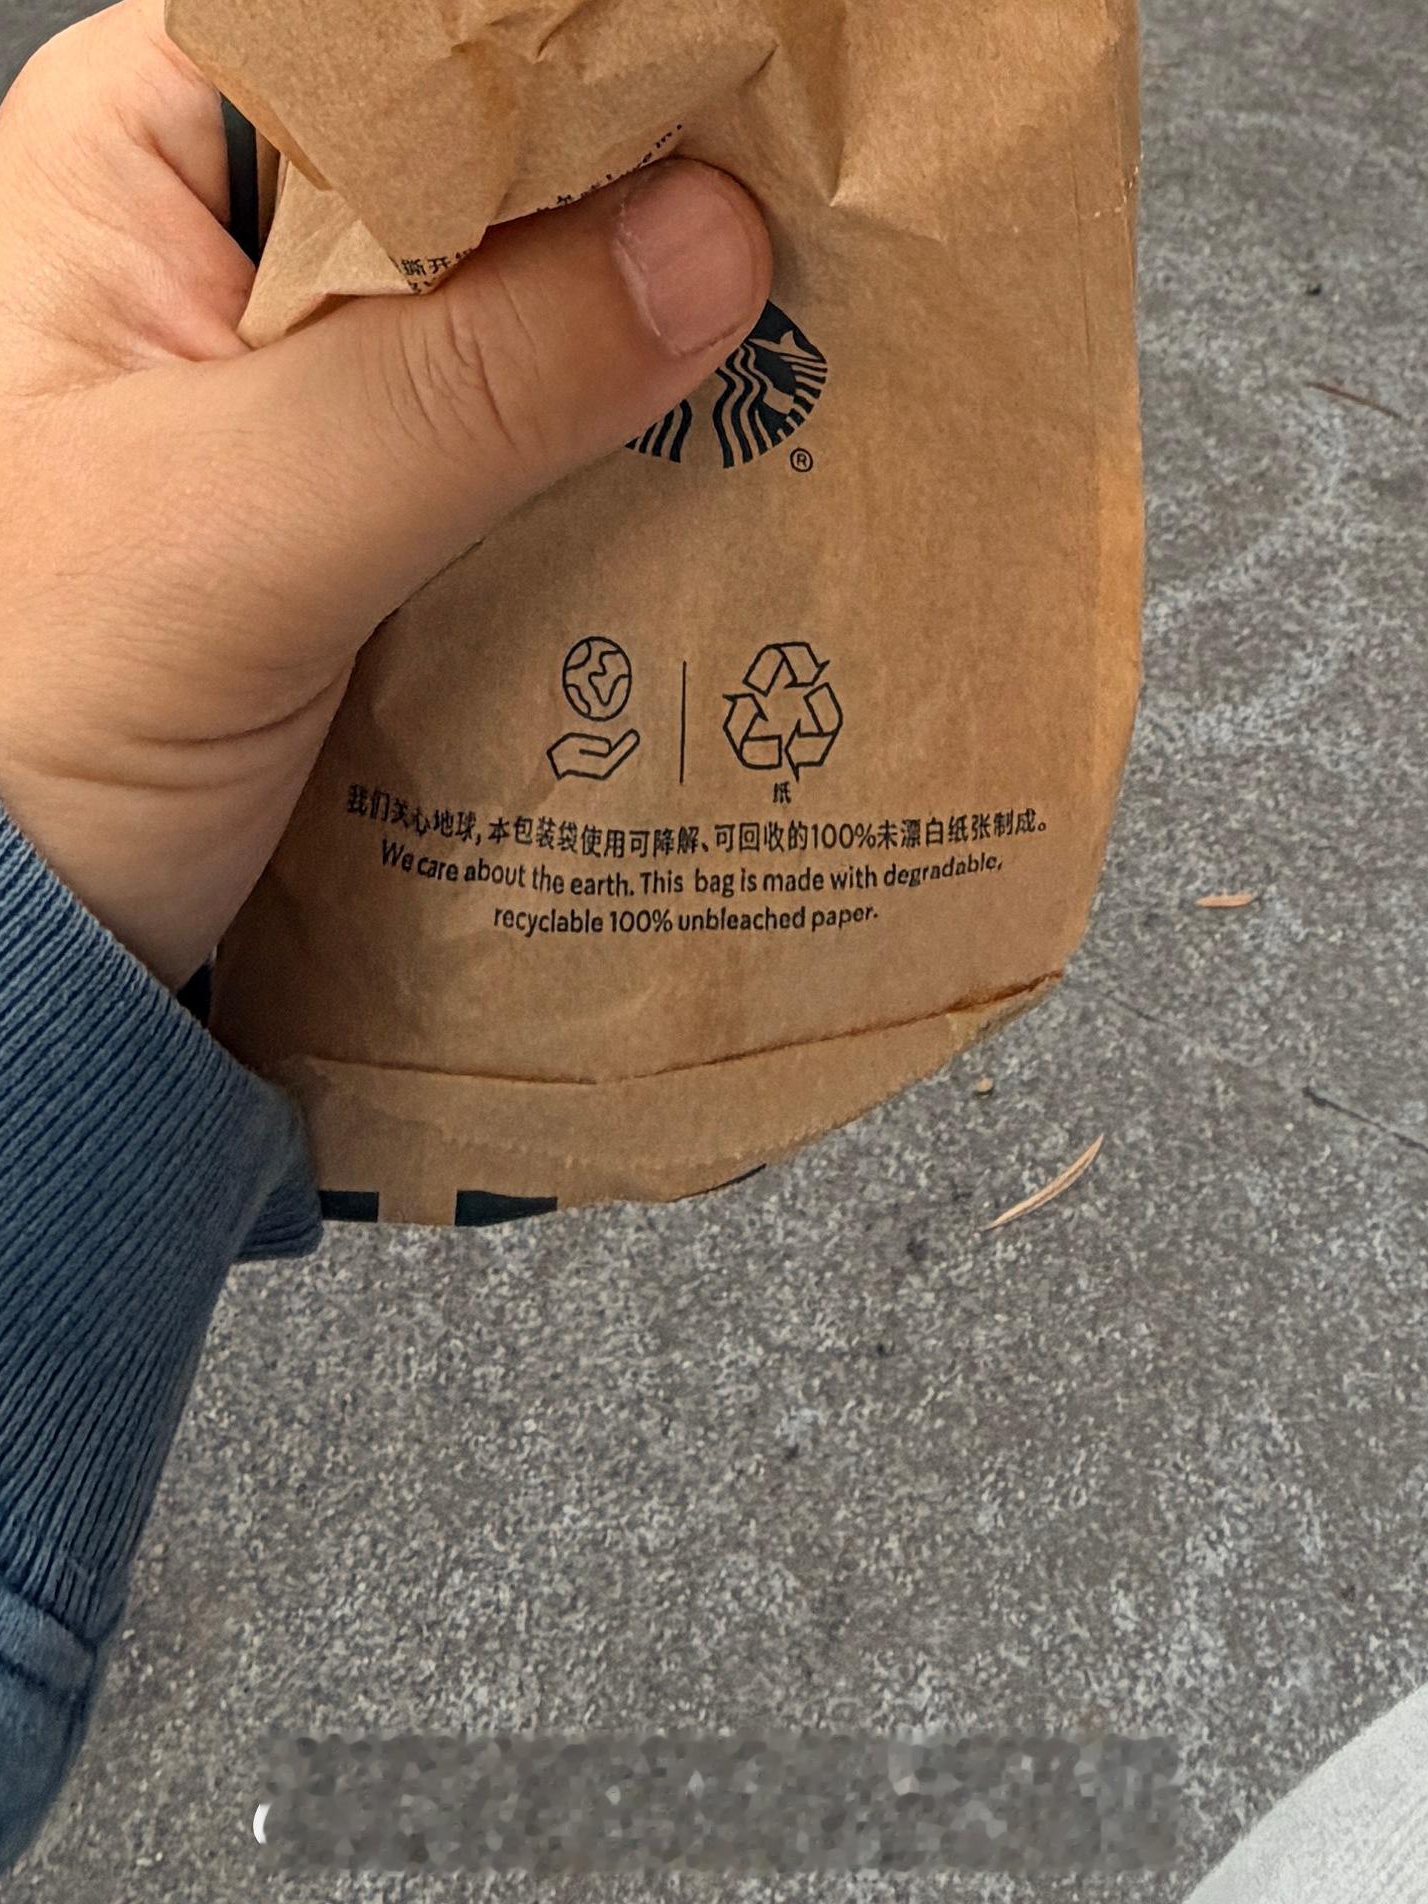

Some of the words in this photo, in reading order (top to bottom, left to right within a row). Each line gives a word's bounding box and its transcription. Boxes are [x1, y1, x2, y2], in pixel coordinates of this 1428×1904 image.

[772, 781, 792, 804] 纸
[380, 839, 413, 873] We
[416, 855, 459, 882] care
[463, 858, 526, 889] about
[532, 864, 565, 894] the
[570, 871, 635, 897] earth.
[639, 870, 684, 894] This
[694, 867, 735, 898] bag
[740, 868, 757, 893] is
[762, 866, 824, 893] made
[830, 864, 878, 890] with
[883, 851, 1004, 888] degradable,
[493, 906, 604, 939] recyclable
[609, 908, 673, 934] 100%
[677, 905, 806, 933] unbleached
[811, 904, 879, 932] paper.
